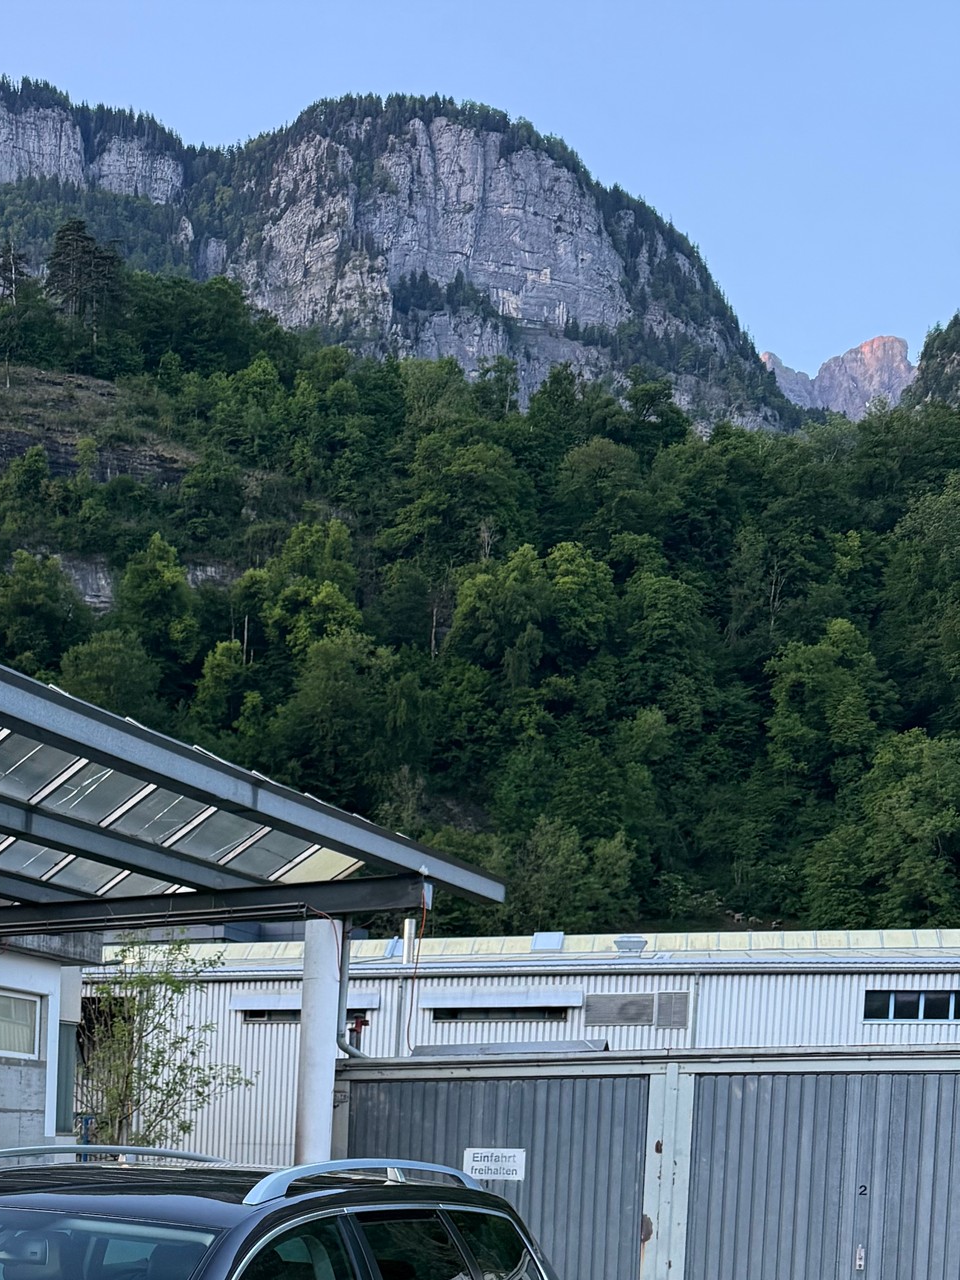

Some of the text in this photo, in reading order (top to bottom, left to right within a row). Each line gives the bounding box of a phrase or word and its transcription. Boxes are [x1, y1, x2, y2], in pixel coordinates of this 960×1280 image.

[472, 1152, 517, 1163] Einfahrt
[470, 1166, 518, 1176] freihalten
[858, 1184, 868, 1196] 2
